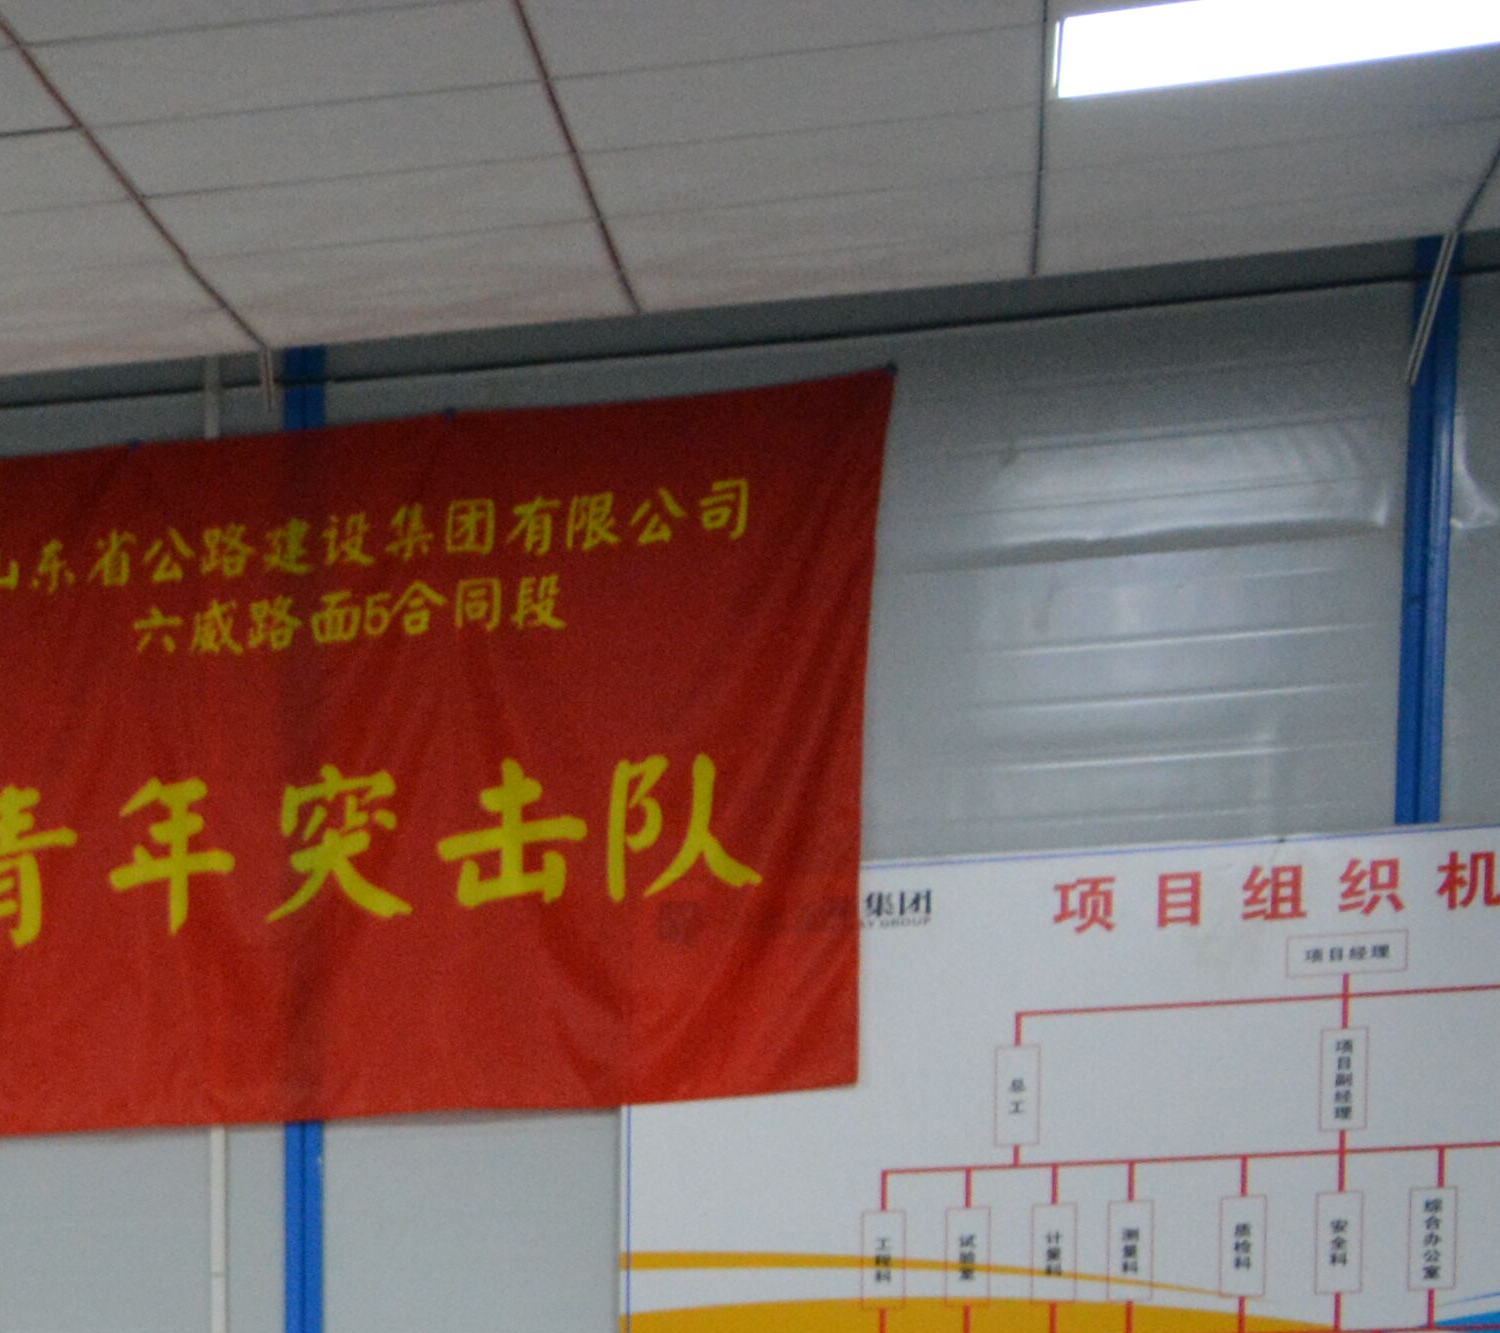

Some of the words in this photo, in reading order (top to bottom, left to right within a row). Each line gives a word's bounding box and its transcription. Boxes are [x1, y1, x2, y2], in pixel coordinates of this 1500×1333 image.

[133, 574, 567, 657] 六威路面5合同段
[1053, 850, 1499, 934] 项目组织机
[1304, 943, 1391, 964] 项目经理
[1009, 1077, 1026, 1115] 总工
[1334, 1038, 1354, 1120] 项目副经理
[1234, 1222, 1252, 1270] 质检科
[1329, 1218, 1348, 1266] 安全科
[1422, 1198, 1443, 1280] 综合办公室
